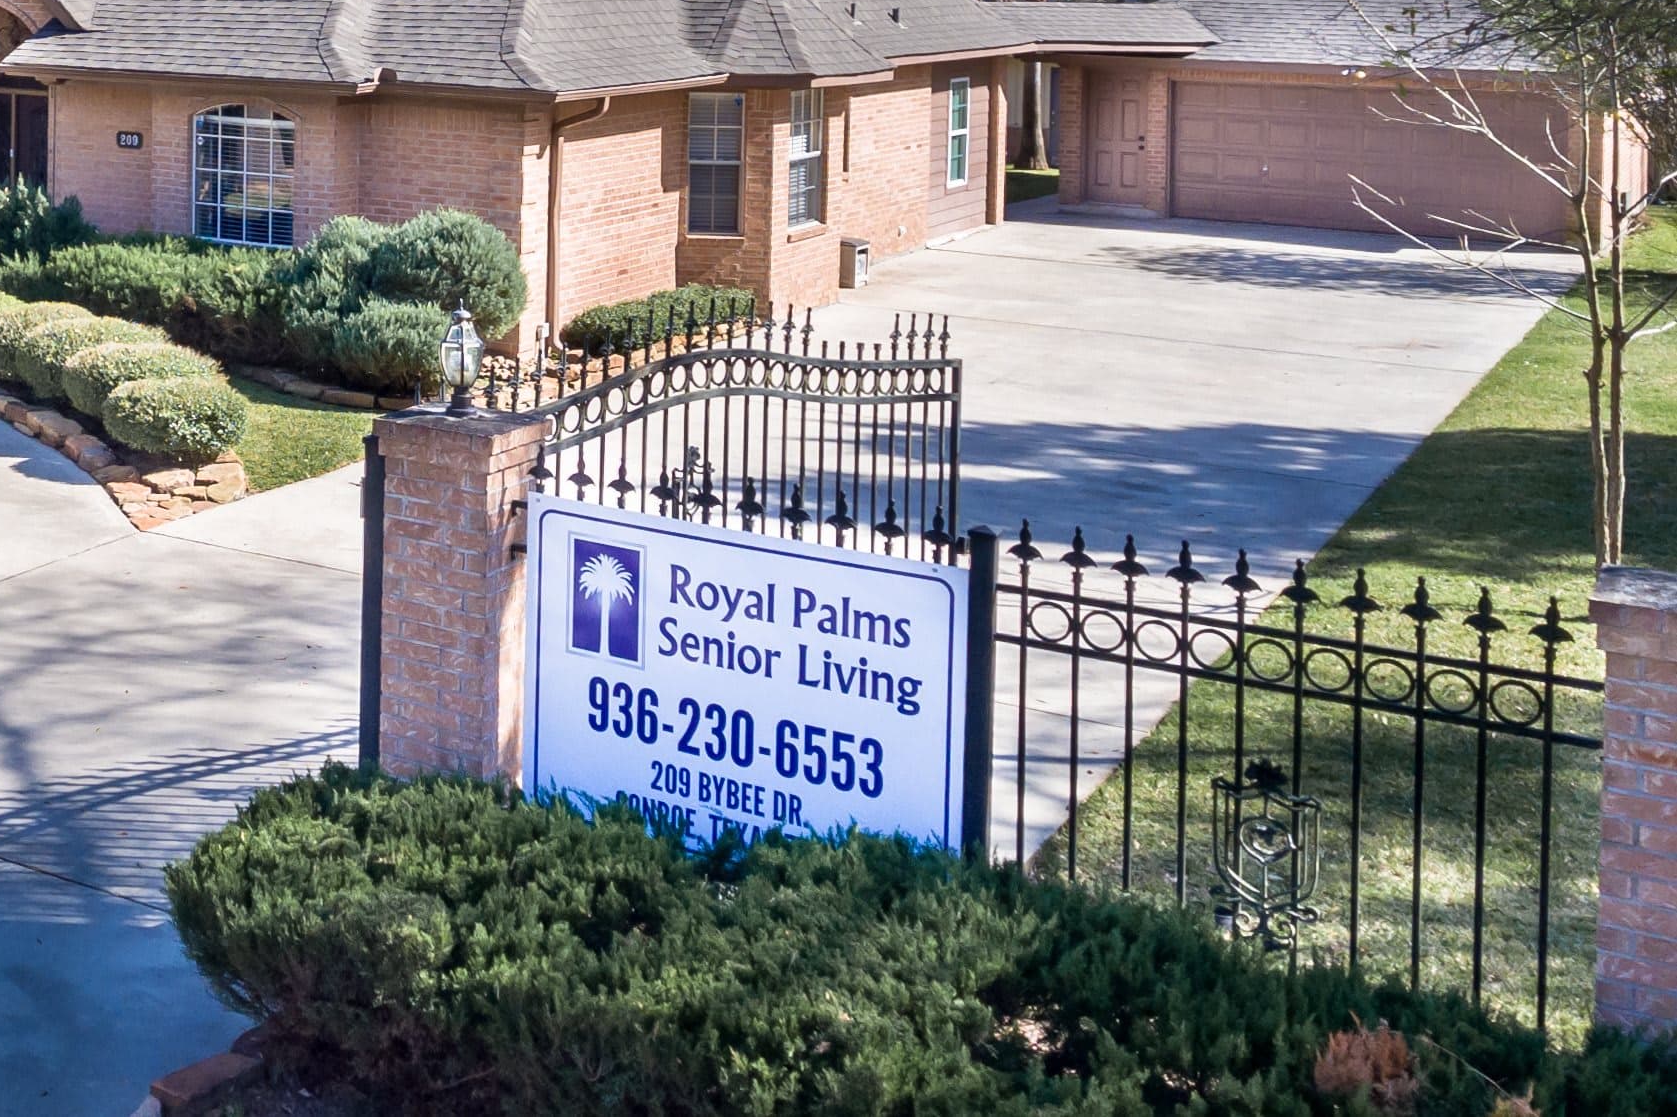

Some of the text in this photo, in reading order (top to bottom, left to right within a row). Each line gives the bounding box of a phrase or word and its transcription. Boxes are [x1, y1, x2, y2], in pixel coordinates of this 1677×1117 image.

[120, 134, 139, 146] 209
[670, 564, 912, 648] Royal Palms
[658, 618, 923, 715] Senior Living
[588, 677, 884, 798] 936-230-6553
[651, 761, 810, 829] 209 BYBEE DR.
